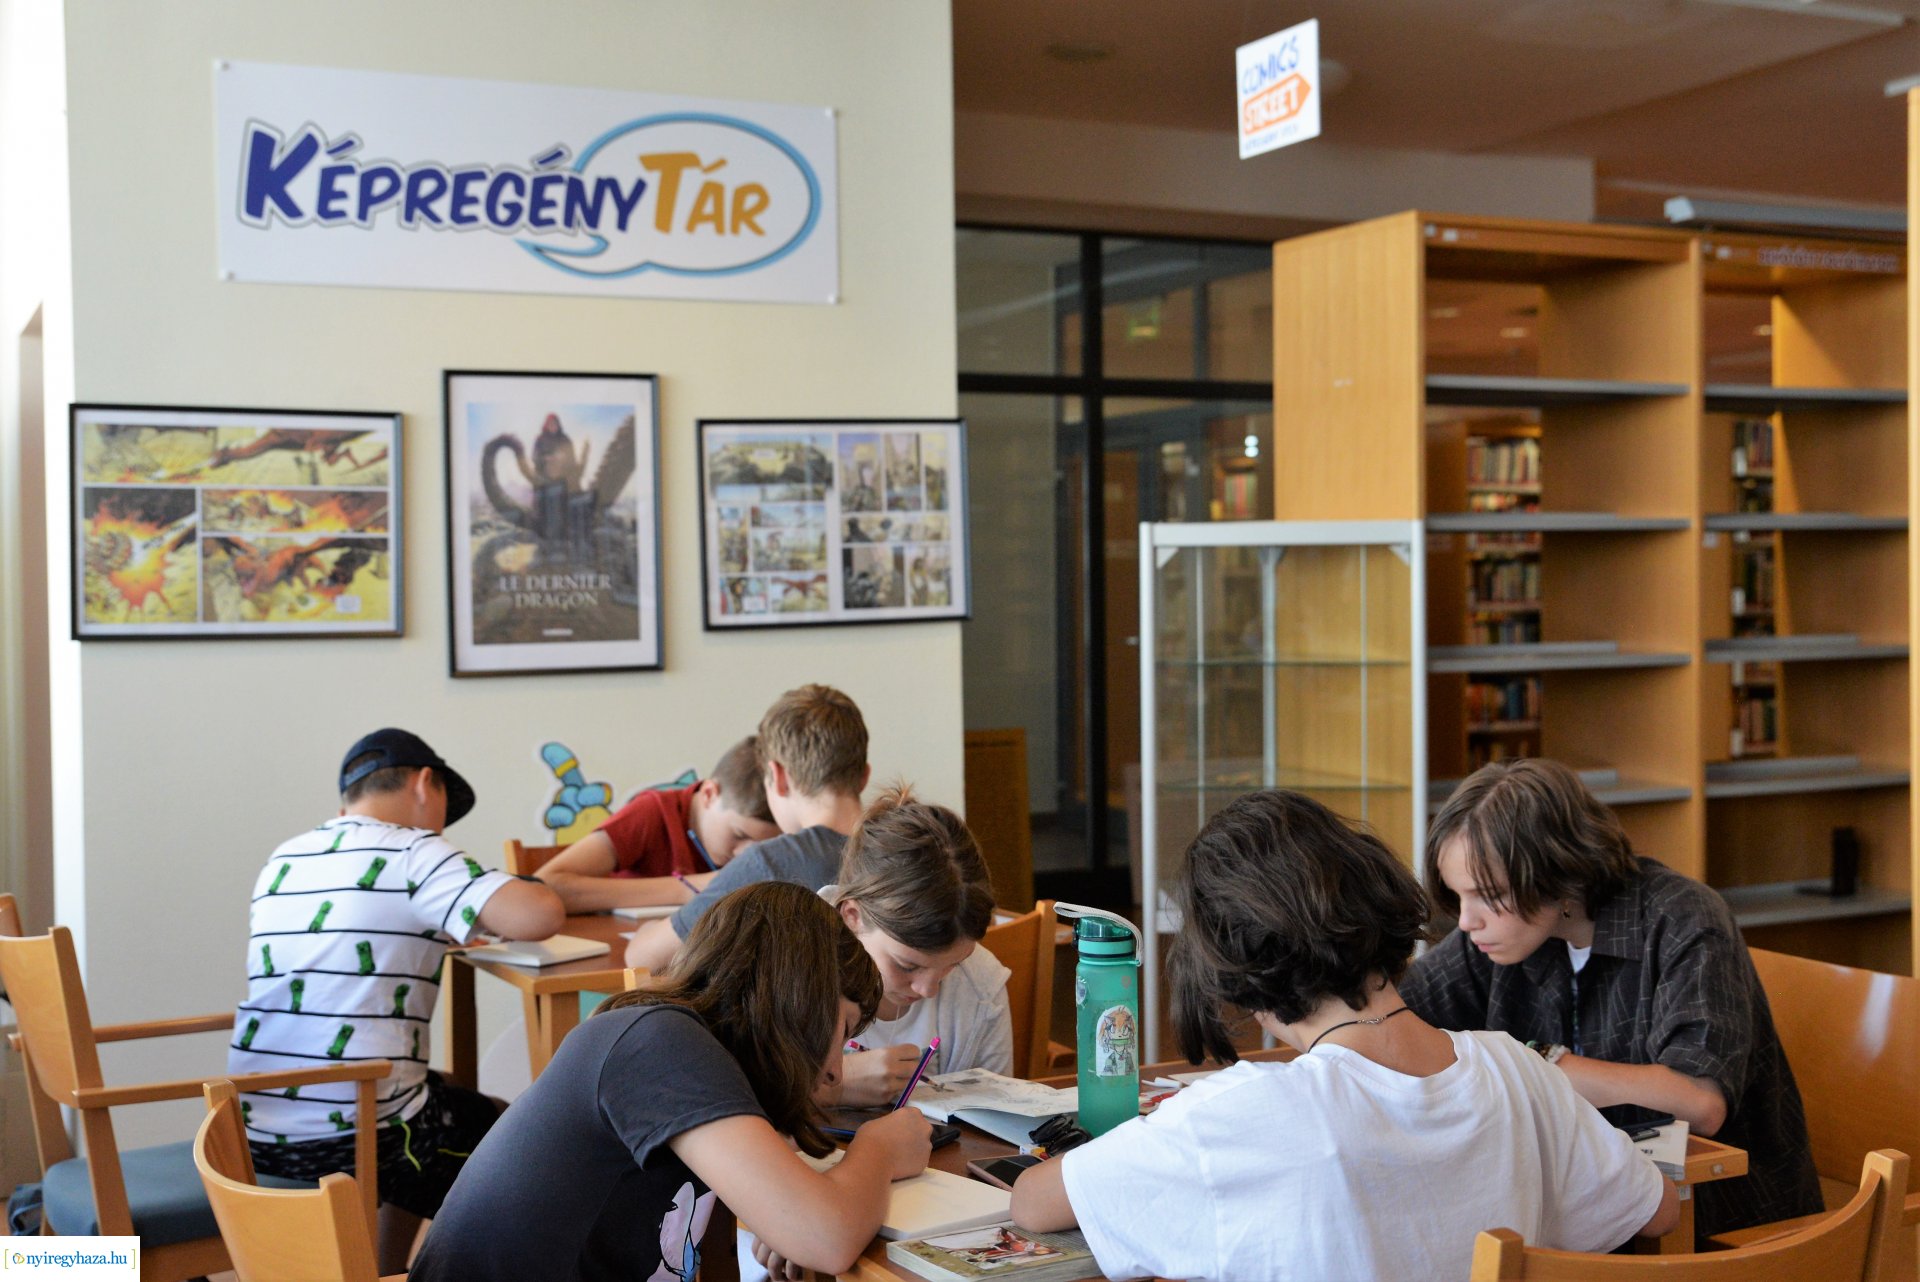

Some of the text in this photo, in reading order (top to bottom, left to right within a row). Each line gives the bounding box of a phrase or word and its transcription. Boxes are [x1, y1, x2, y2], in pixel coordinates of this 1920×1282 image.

[1242, 35, 1299, 94] COMICS
[500, 573, 612, 592] LE DERNIER
[515, 591, 599, 611] DRAGON
